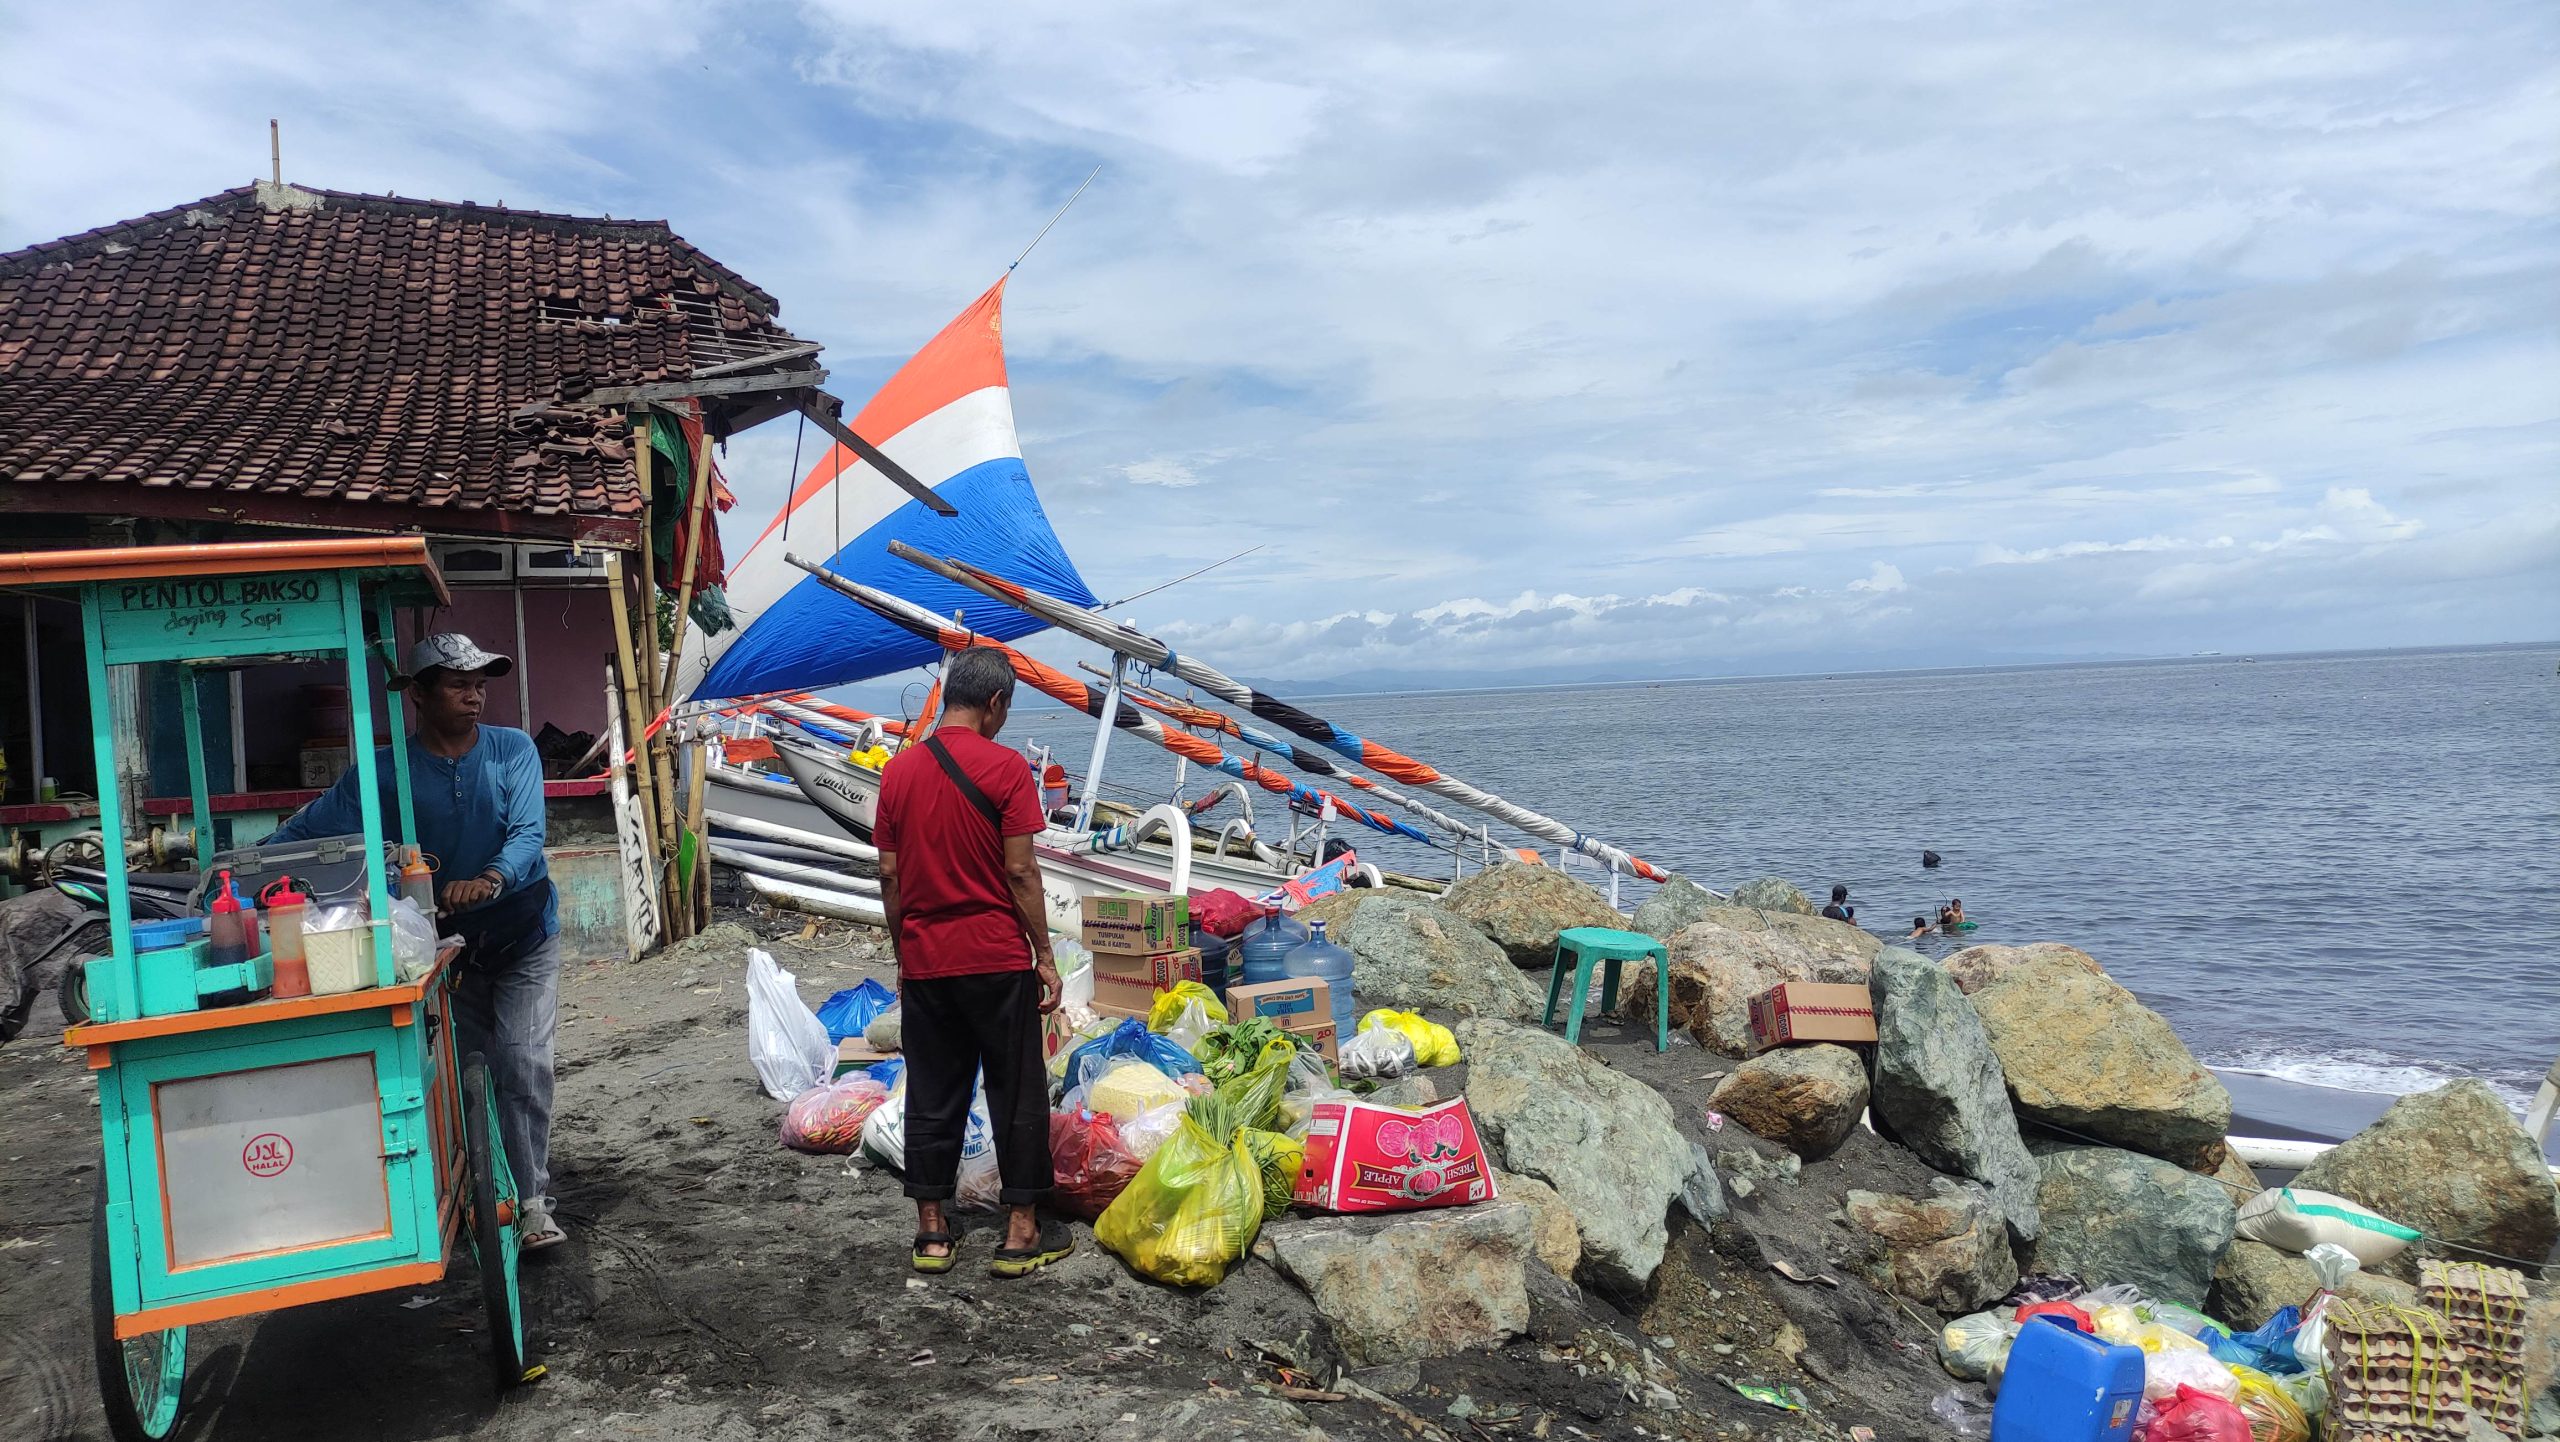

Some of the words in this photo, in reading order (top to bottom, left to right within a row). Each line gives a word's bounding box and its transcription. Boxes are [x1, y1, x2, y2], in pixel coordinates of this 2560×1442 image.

[252, 1160, 285, 1170] HALAL
[1447, 1161, 1475, 1180] FRESH
[1363, 1170, 1400, 1186] APPLE
